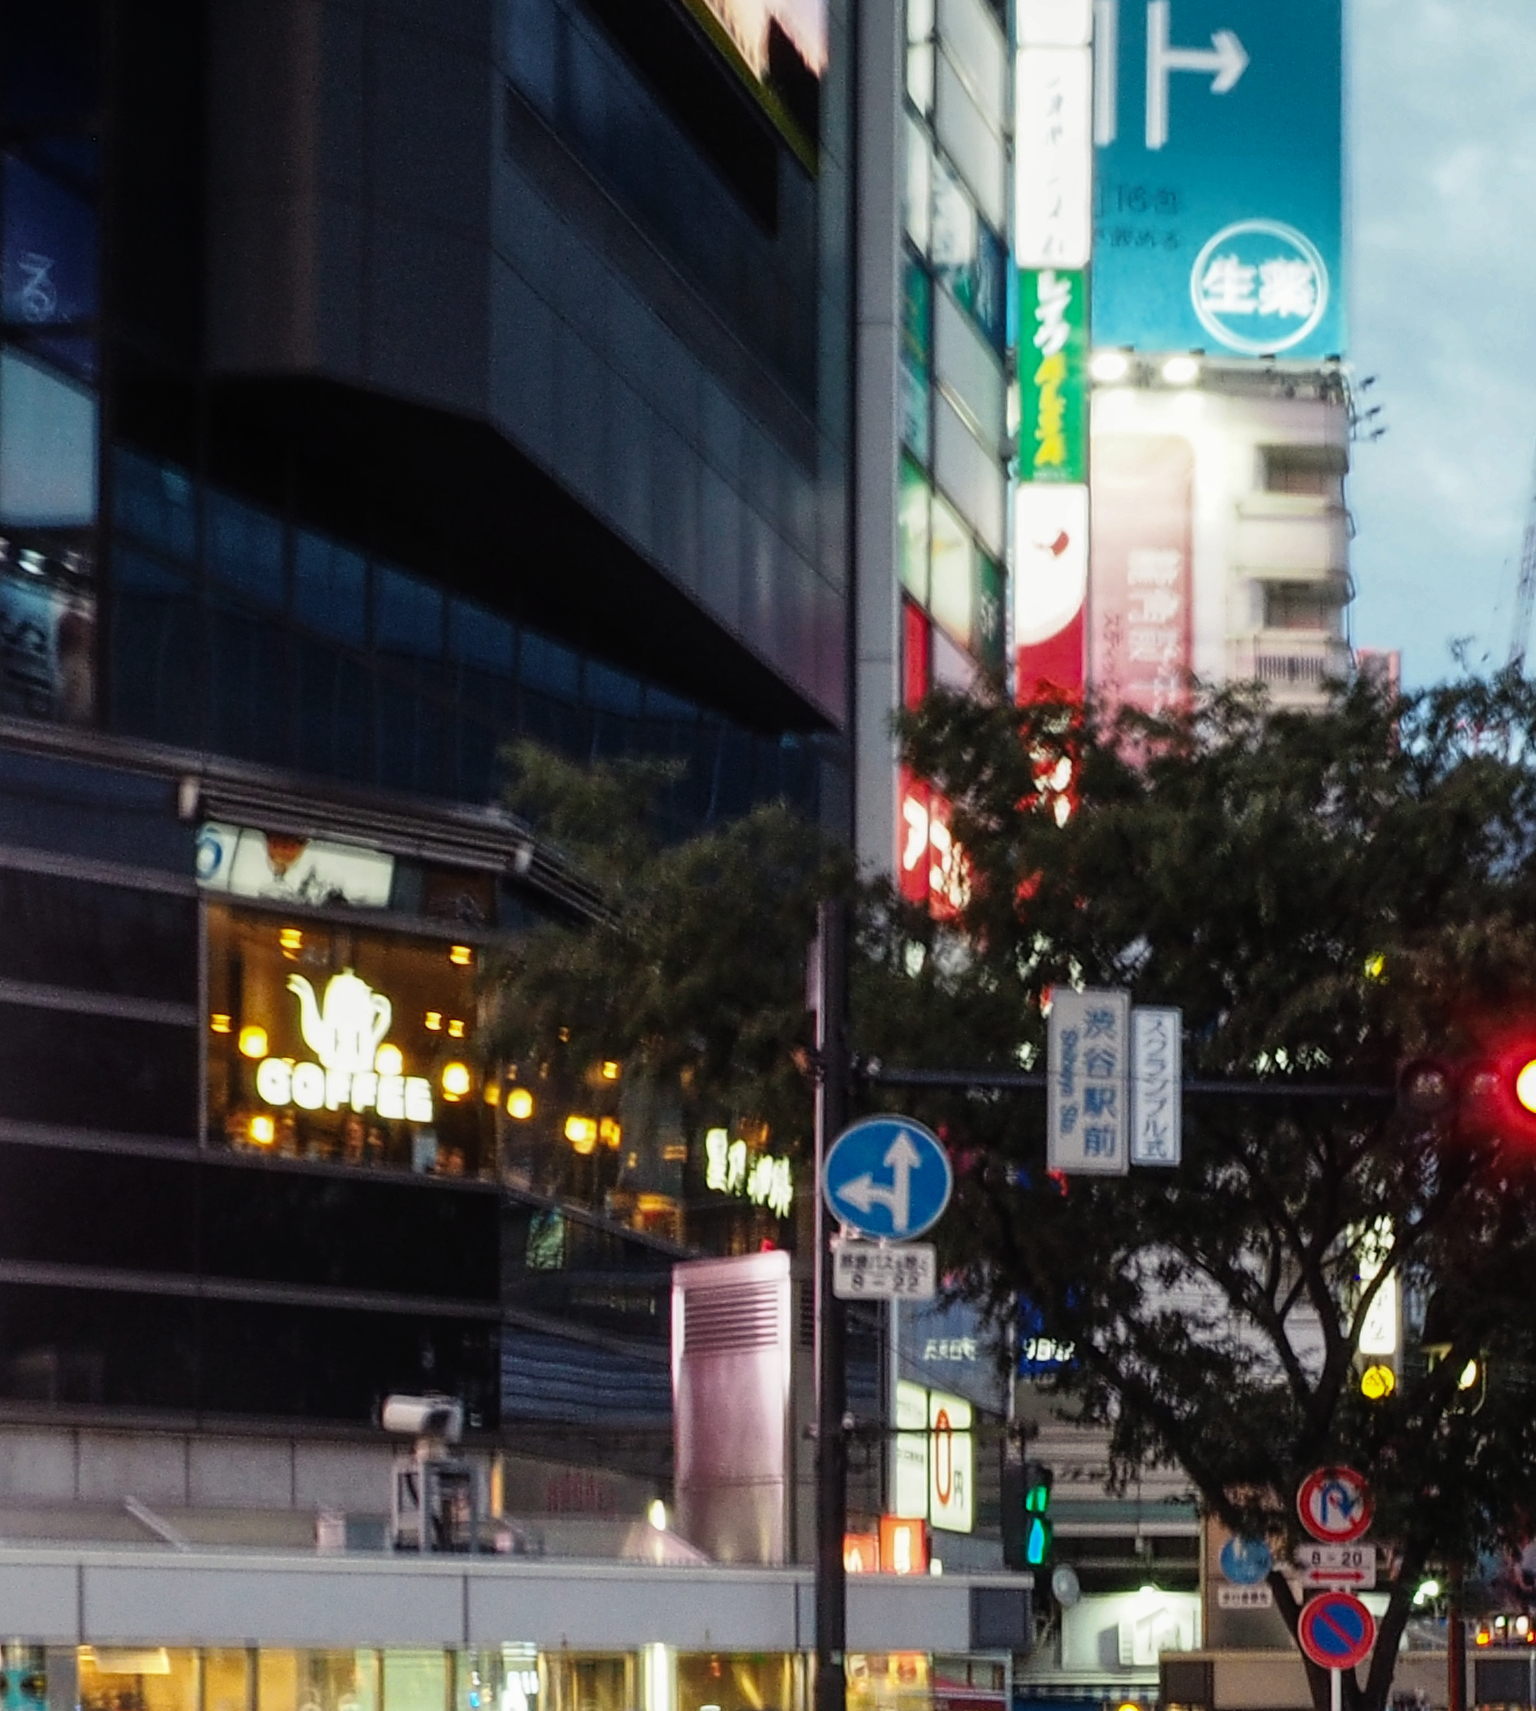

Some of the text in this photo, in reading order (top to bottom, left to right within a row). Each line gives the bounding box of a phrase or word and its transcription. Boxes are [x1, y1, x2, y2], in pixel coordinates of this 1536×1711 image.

[256, 1054, 434, 1123] COFFEE
[1084, 1005, 1117, 1158] 渋谷駅前
[1144, 1018, 1170, 1160] スクランブル式
